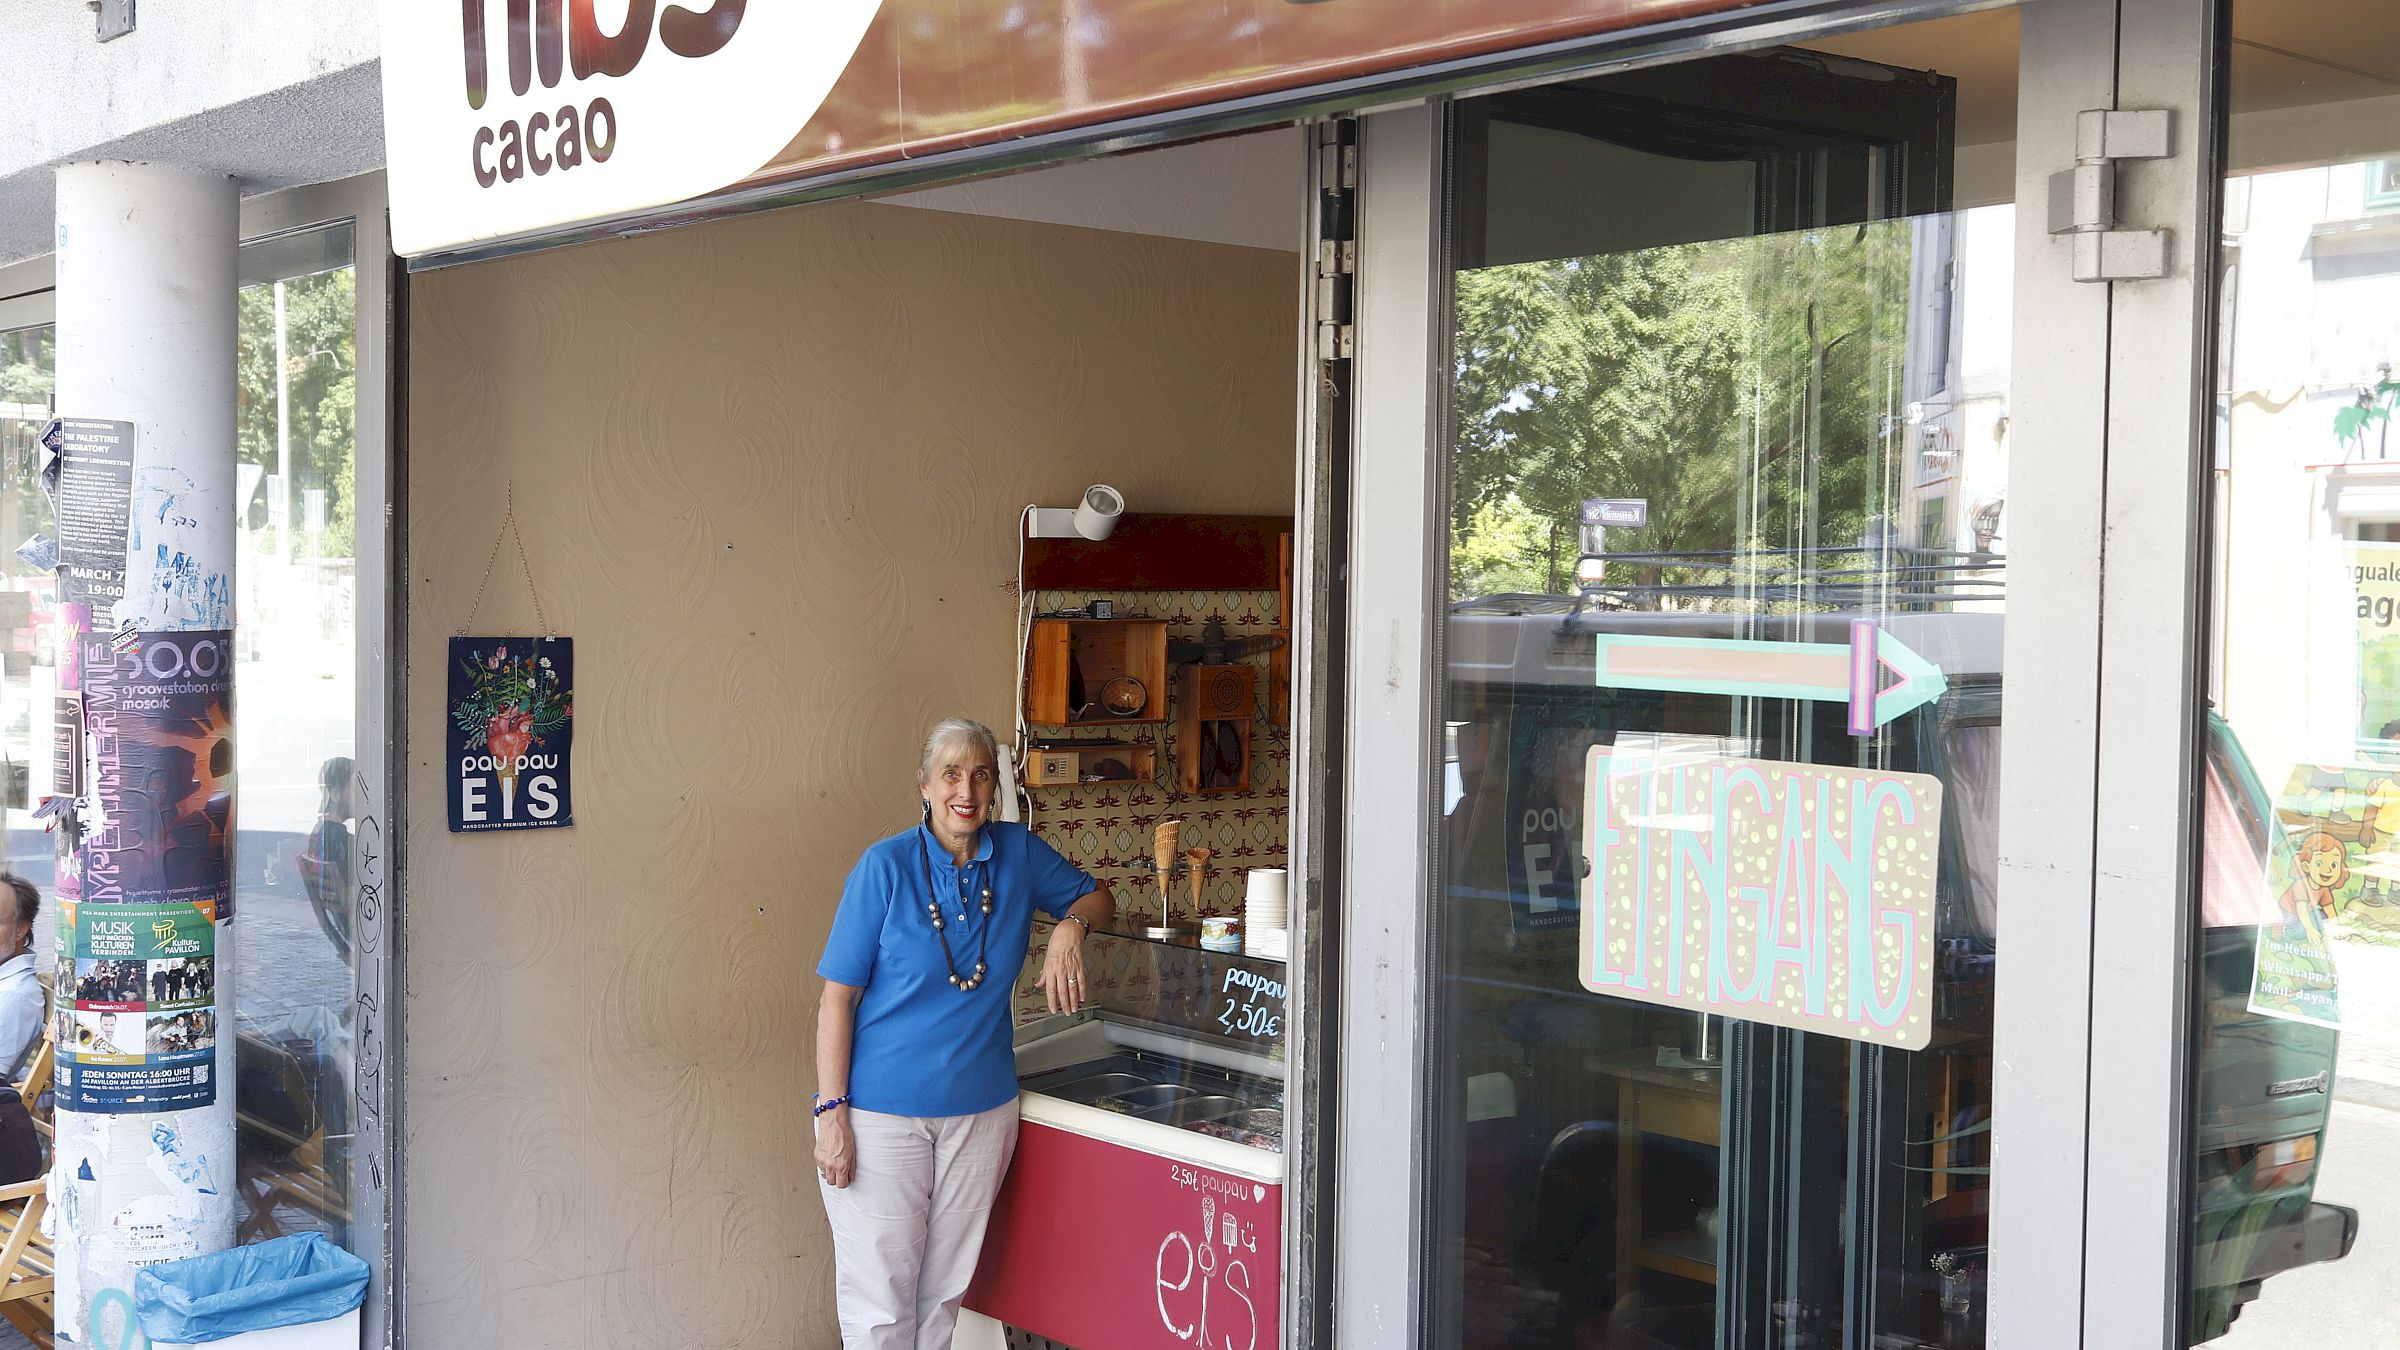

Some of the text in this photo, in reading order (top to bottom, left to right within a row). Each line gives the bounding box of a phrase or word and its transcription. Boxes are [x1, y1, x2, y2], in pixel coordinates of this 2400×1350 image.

[473, 97, 616, 188] cacao
[64, 433, 75, 441] THE
[76, 434, 120, 444] PALESTINE
[64, 443, 110, 454] LABORATORY
[90, 458, 131, 467] LOEWENSTEIN
[71, 567, 125, 582] MARCH 7
[87, 584, 124, 597] 19:00
[111, 631, 138, 648] RACISM
[122, 681, 209, 699] groovestation
[122, 695, 171, 711] mosaik
[461, 753, 558, 778] pau pau
[462, 775, 559, 821] EIS
[1523, 807, 1577, 843] pau
[1592, 752, 1916, 1029] EINGANG
[202, 907, 211, 915] 07
[91, 920, 135, 935] MUSIK
[1529, 917, 1575, 926] HANDCRAFTED
[91, 940, 135, 950] KULTUREN
[164, 944, 200, 955] PAVILLON
[172, 938, 193, 947] Kultur
[2265, 940, 2280, 951] Im
[1222, 967, 1286, 1004] paupau
[2260, 981, 2293, 997] Mail:
[1217, 998, 1281, 1037] 2,50€
[81, 1067, 191, 1079] JEDEN SONNTAG 16:00 UHR
[145, 1075, 190, 1085] ALBERTBRÜCKE
[1171, 1165, 1248, 1204] 2,50€ paupau
[1156, 1230, 1257, 1350] eis
